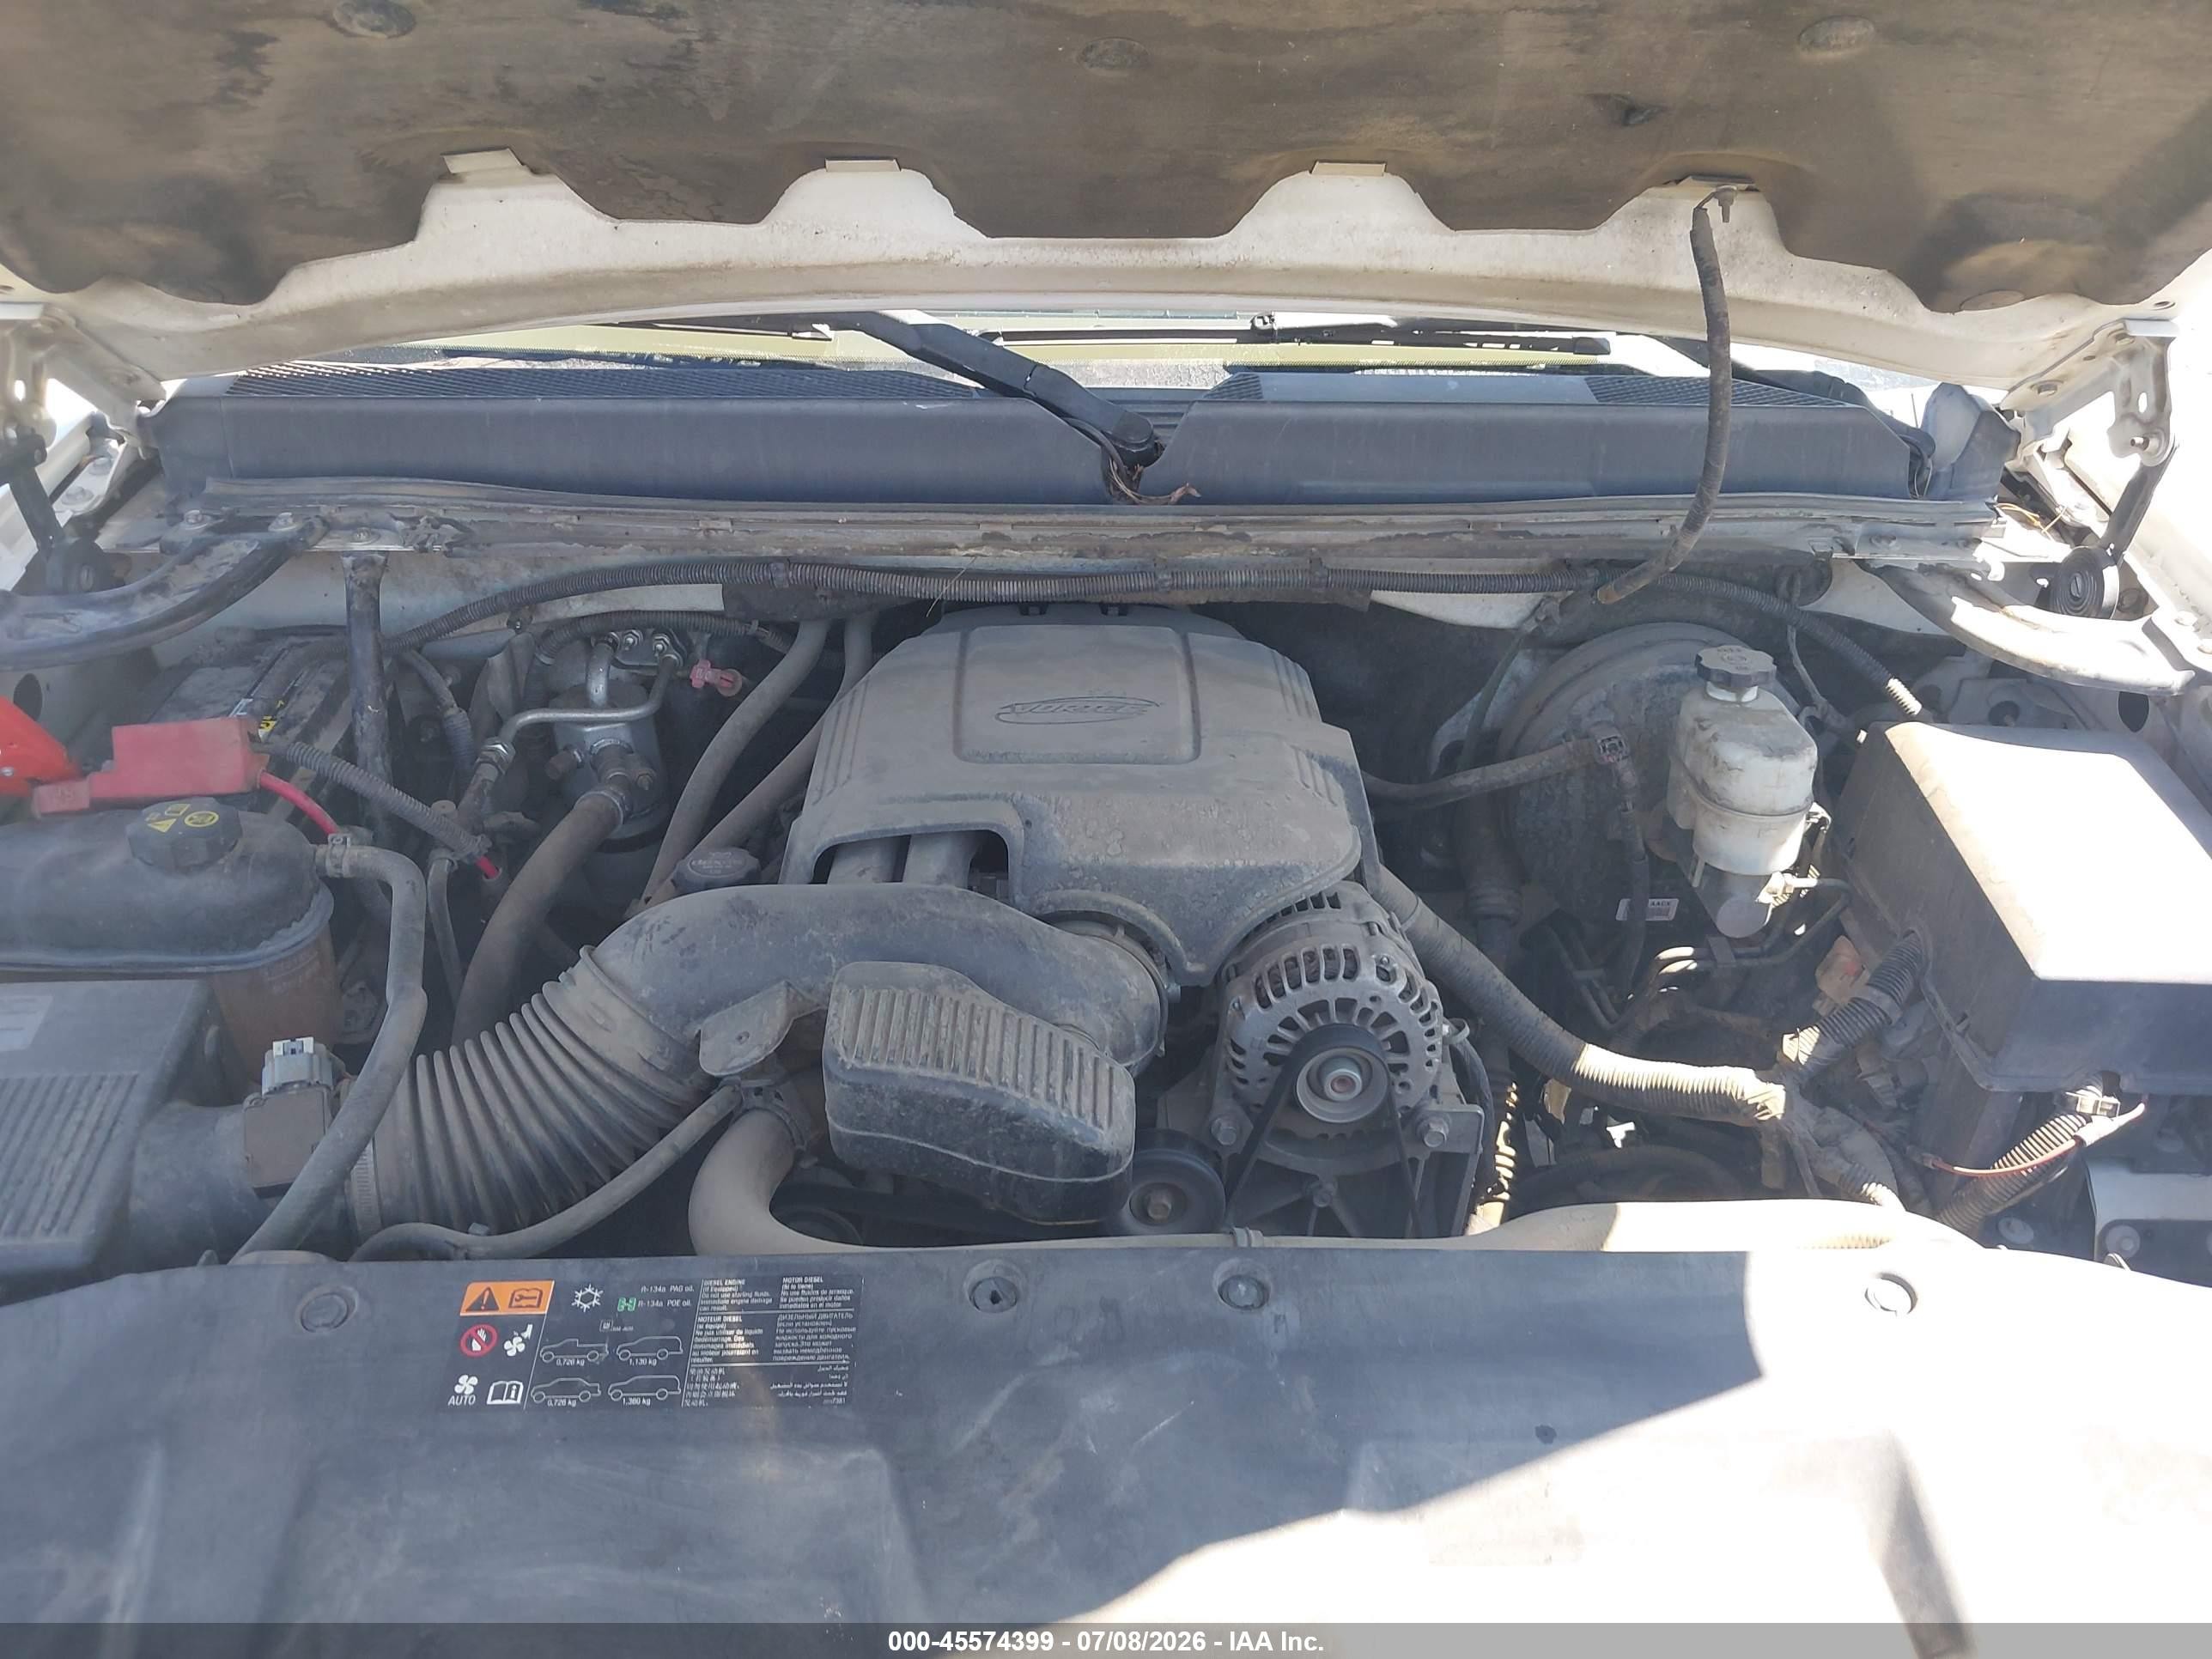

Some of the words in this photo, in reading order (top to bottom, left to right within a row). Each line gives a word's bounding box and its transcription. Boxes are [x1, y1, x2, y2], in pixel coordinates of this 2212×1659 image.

[576, 1358, 586, 1367] kg
[648, 1358, 658, 1367] kg
[447, 1395, 476, 1407] AUTO
[568, 1399, 577, 1407] kg
[642, 1397, 651, 1407] kg
